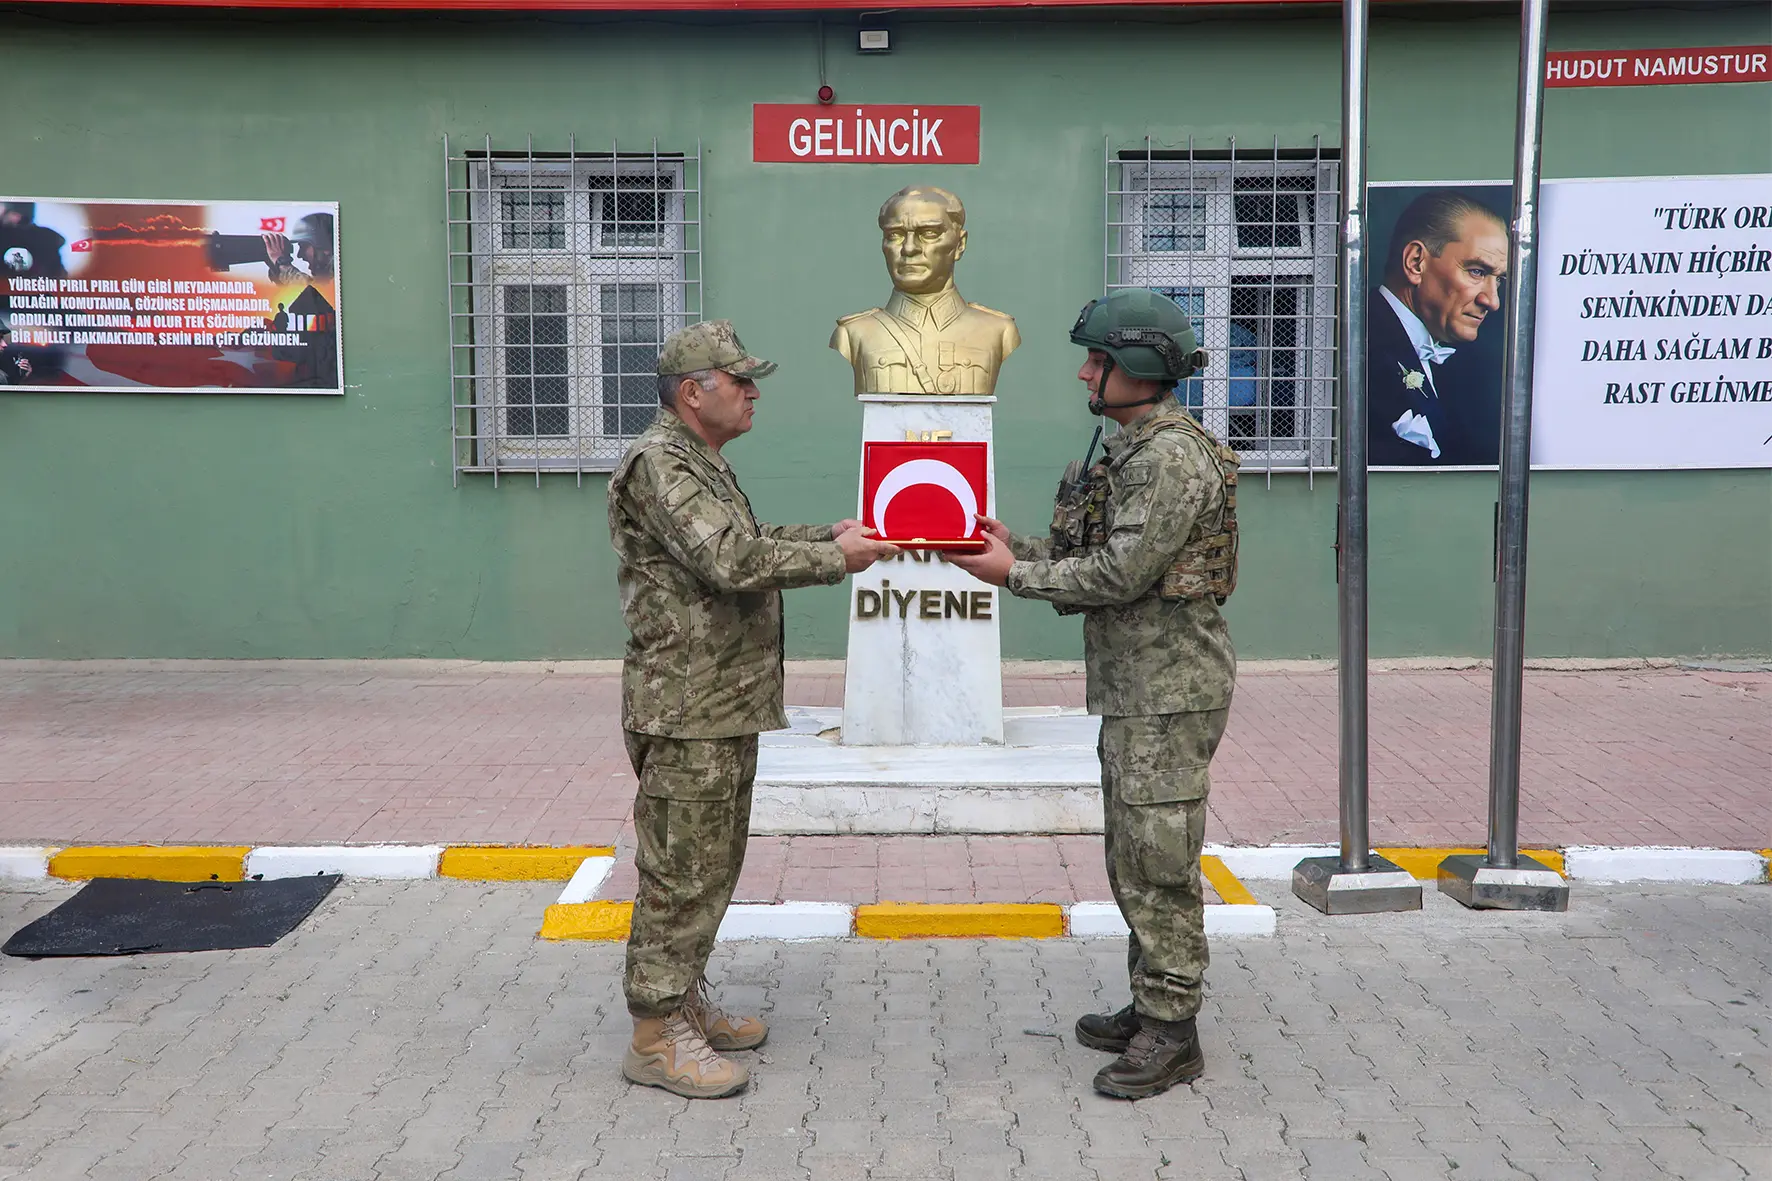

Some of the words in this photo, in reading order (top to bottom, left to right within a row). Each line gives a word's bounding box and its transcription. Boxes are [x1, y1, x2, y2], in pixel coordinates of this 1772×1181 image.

[1547, 58, 1627, 80] HUDUT
[1634, 53, 1768, 78] NAMUSTUR
[789, 109, 943, 157] GELİNCİK
[1654, 203, 1728, 230] "TÜRK
[1734, 206, 1772, 229] OR
[1558, 248, 1684, 276] DÜNYANIN
[1686, 243, 1772, 279] HİÇBİR
[8, 276, 58, 293] YÜREĞİN
[60, 279, 89, 293] PIRIL
[91, 279, 120, 293] PIRIL
[122, 278, 146, 293] GÜN
[147, 278, 172, 294] GİBİ
[174, 281, 257, 295] MEYDANDADIR,
[9, 294, 59, 310] KULAĞIN
[60, 296, 133, 311] KOMUTANDA,
[135, 296, 185, 311] GÖZÜNSE
[188, 296, 272, 313] DÜŞMANDADIR,
[1580, 289, 1742, 319] SENİNKİNDEN
[10, 313, 63, 327] ORDULAR
[65, 314, 134, 328] KIMILDANIR,
[136, 315, 151, 328] AN
[153, 315, 183, 328] OLUR
[184, 315, 205, 328] TEK
[207, 314, 267, 330] SÖZÜNDEN,
[11, 328, 32, 344] BİR
[33, 329, 72, 345] MİLLET
[75, 331, 157, 346] BAKMAKTADIR,
[159, 331, 192, 346] SENİN
[194, 330, 213, 346] BİR
[216, 331, 241, 348] ÇİFT
[242, 331, 308, 346] GÖZÜNDEN...
[1580, 339, 1648, 362] DAHA
[1654, 332, 1753, 361] SAĞLAM
[1603, 382, 1666, 405] RAST
[857, 580, 993, 621] DİYENE
